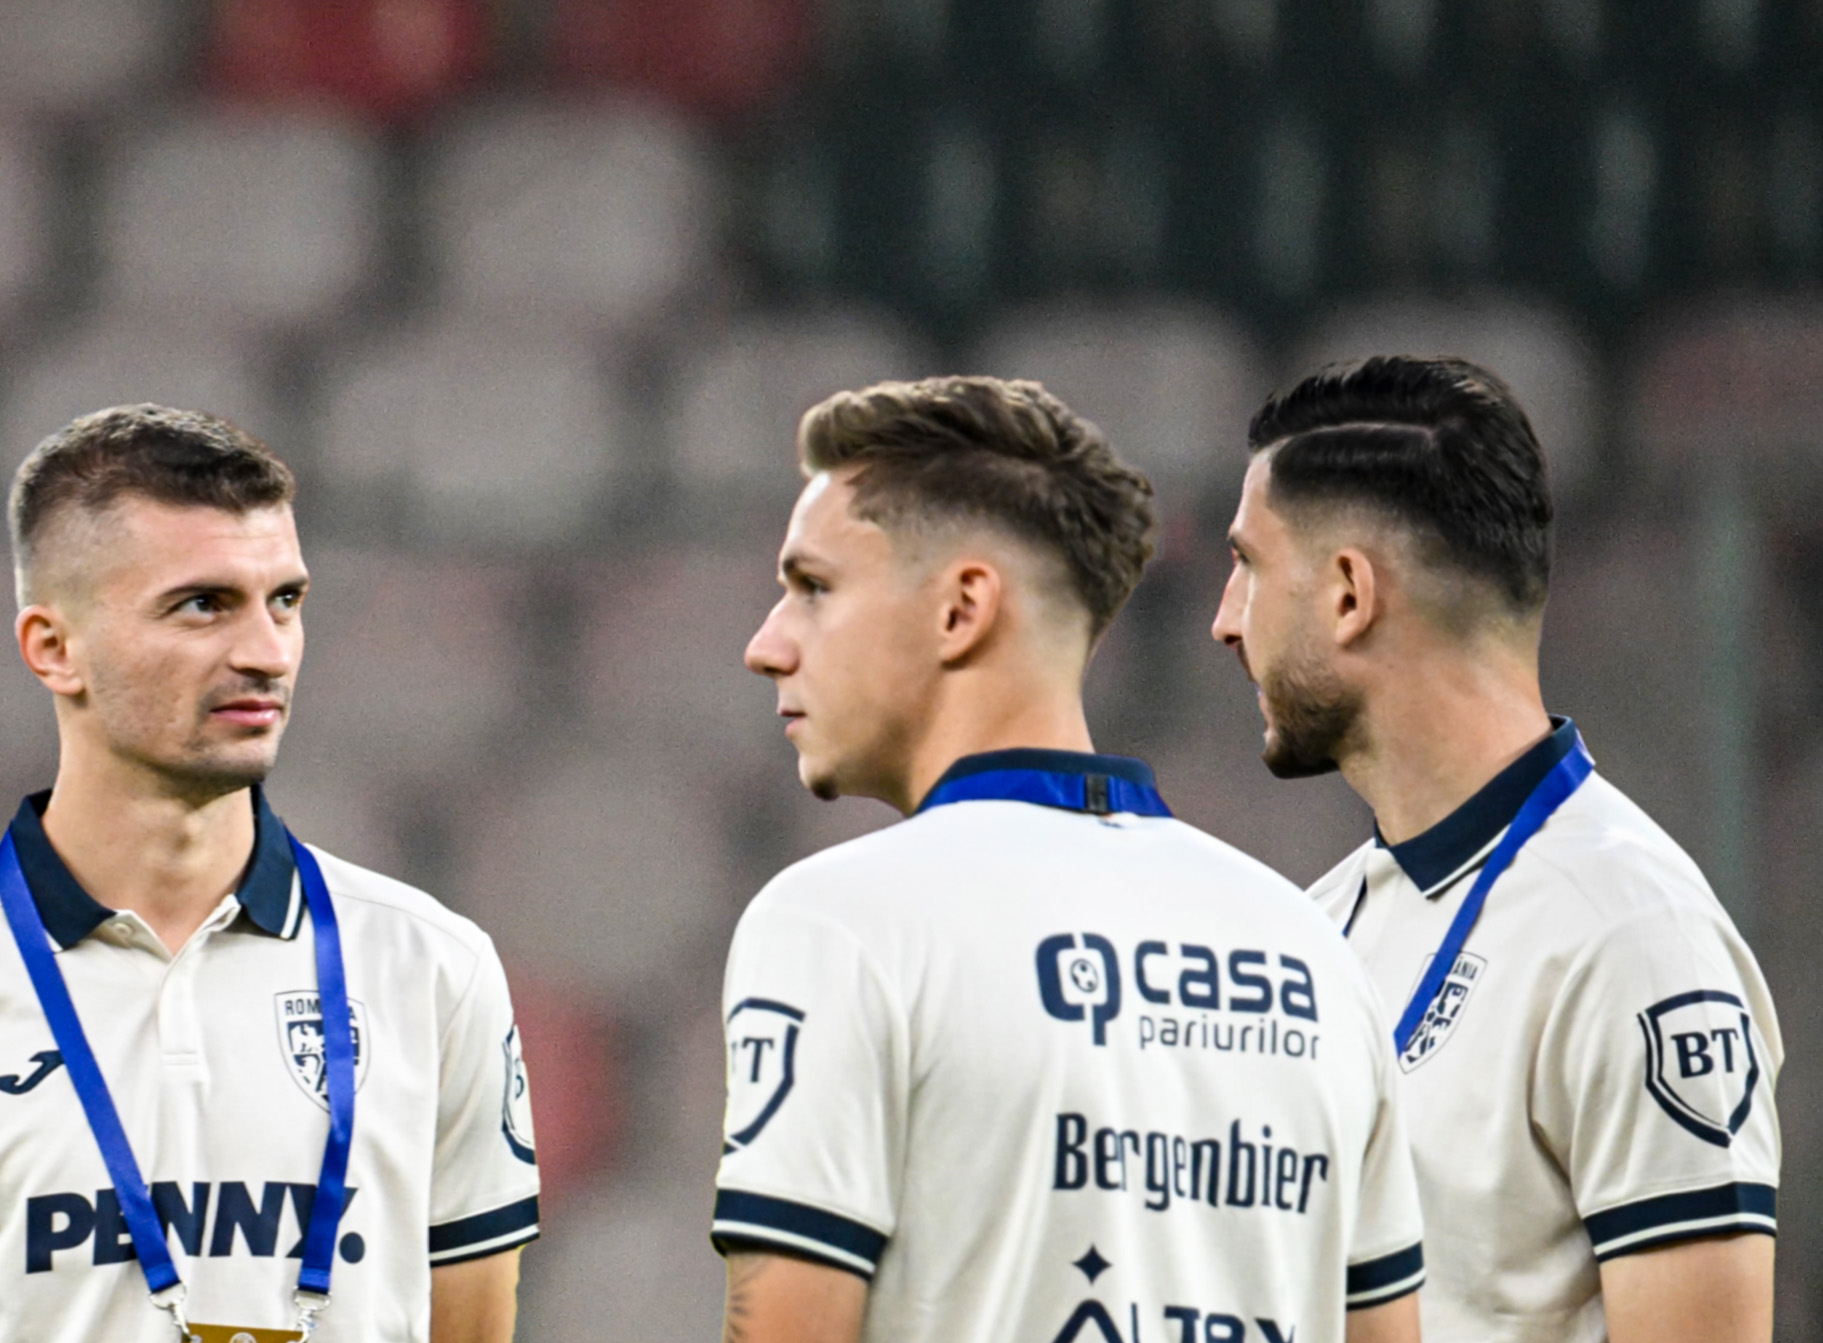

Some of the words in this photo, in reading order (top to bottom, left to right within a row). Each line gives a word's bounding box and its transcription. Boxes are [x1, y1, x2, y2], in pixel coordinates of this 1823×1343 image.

[1134, 940, 1319, 1023] casa
[1139, 1013, 1320, 1061] pariurilor
[1670, 1028, 1740, 1079] BT
[1052, 1112, 1330, 1215] Bergenbier
